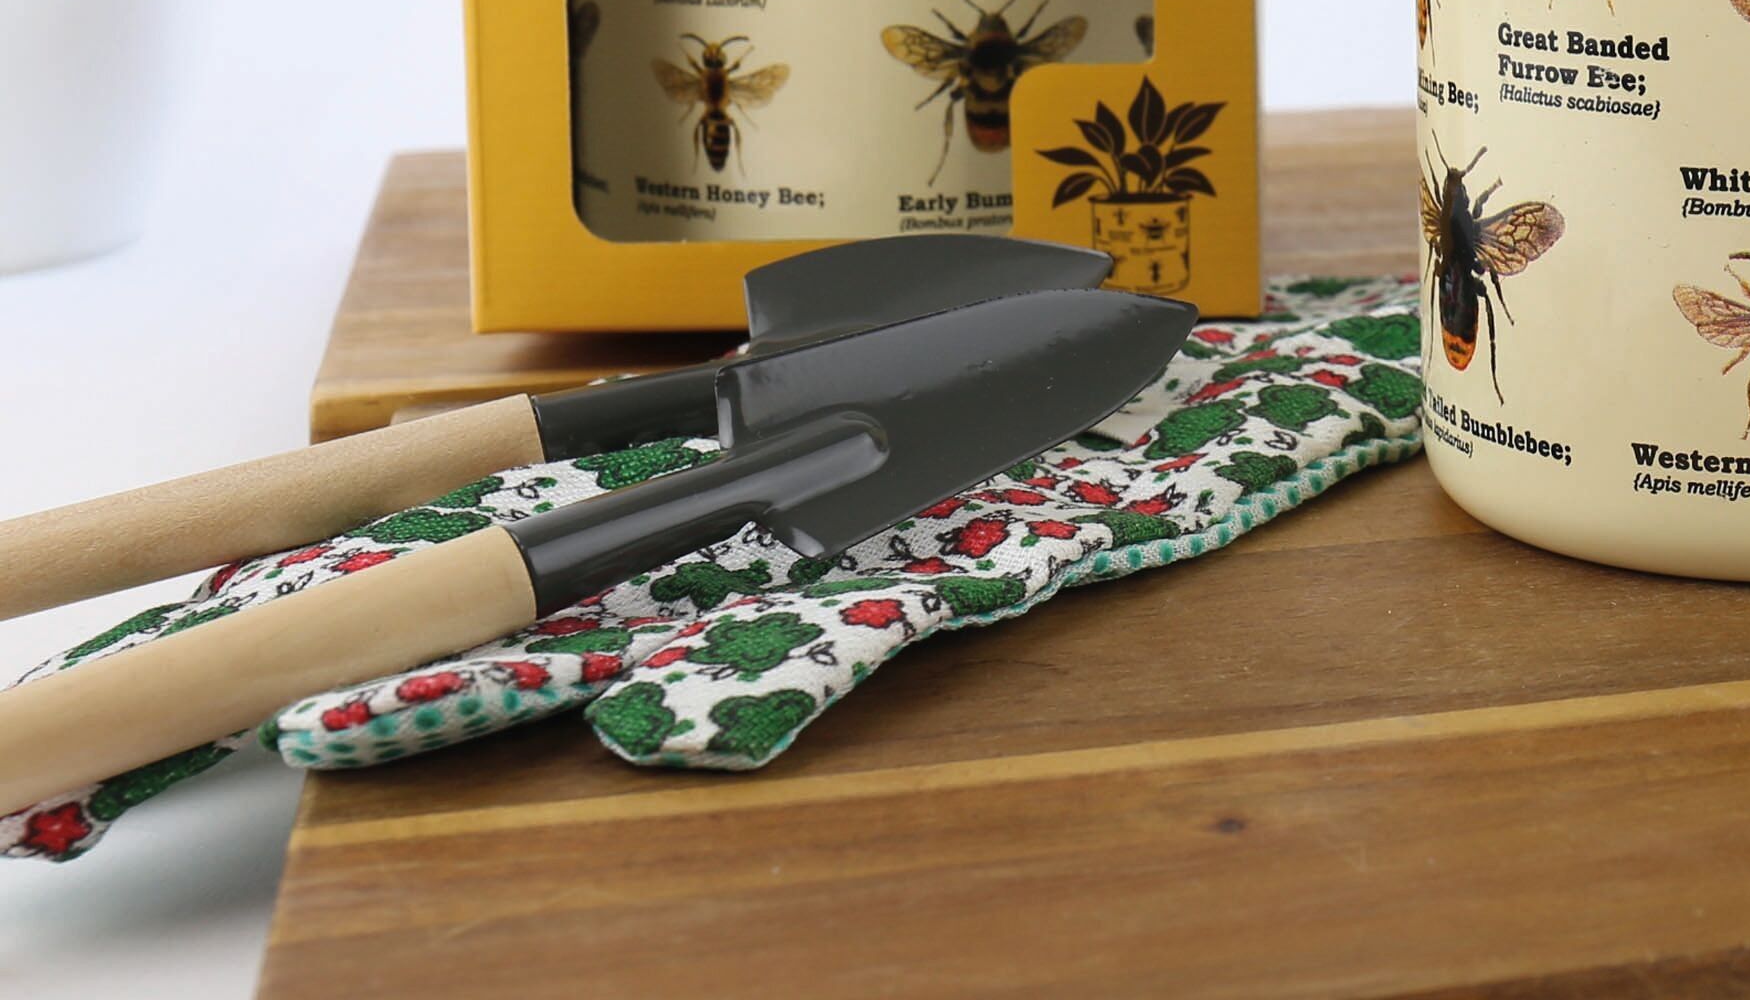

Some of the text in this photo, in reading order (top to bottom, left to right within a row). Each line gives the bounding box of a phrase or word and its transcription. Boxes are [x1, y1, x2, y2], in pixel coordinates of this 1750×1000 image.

[1498, 22, 1670, 61] Great Banded
[1498, 54, 1579, 85] Furrow
[1448, 81, 1479, 114] Bee;
[636, 176, 700, 199] Western
[707, 184, 769, 208] Honey
[778, 187, 825, 208] Bee;
[898, 193, 958, 214] Early
[1461, 409, 1572, 467] Bumblebee;
